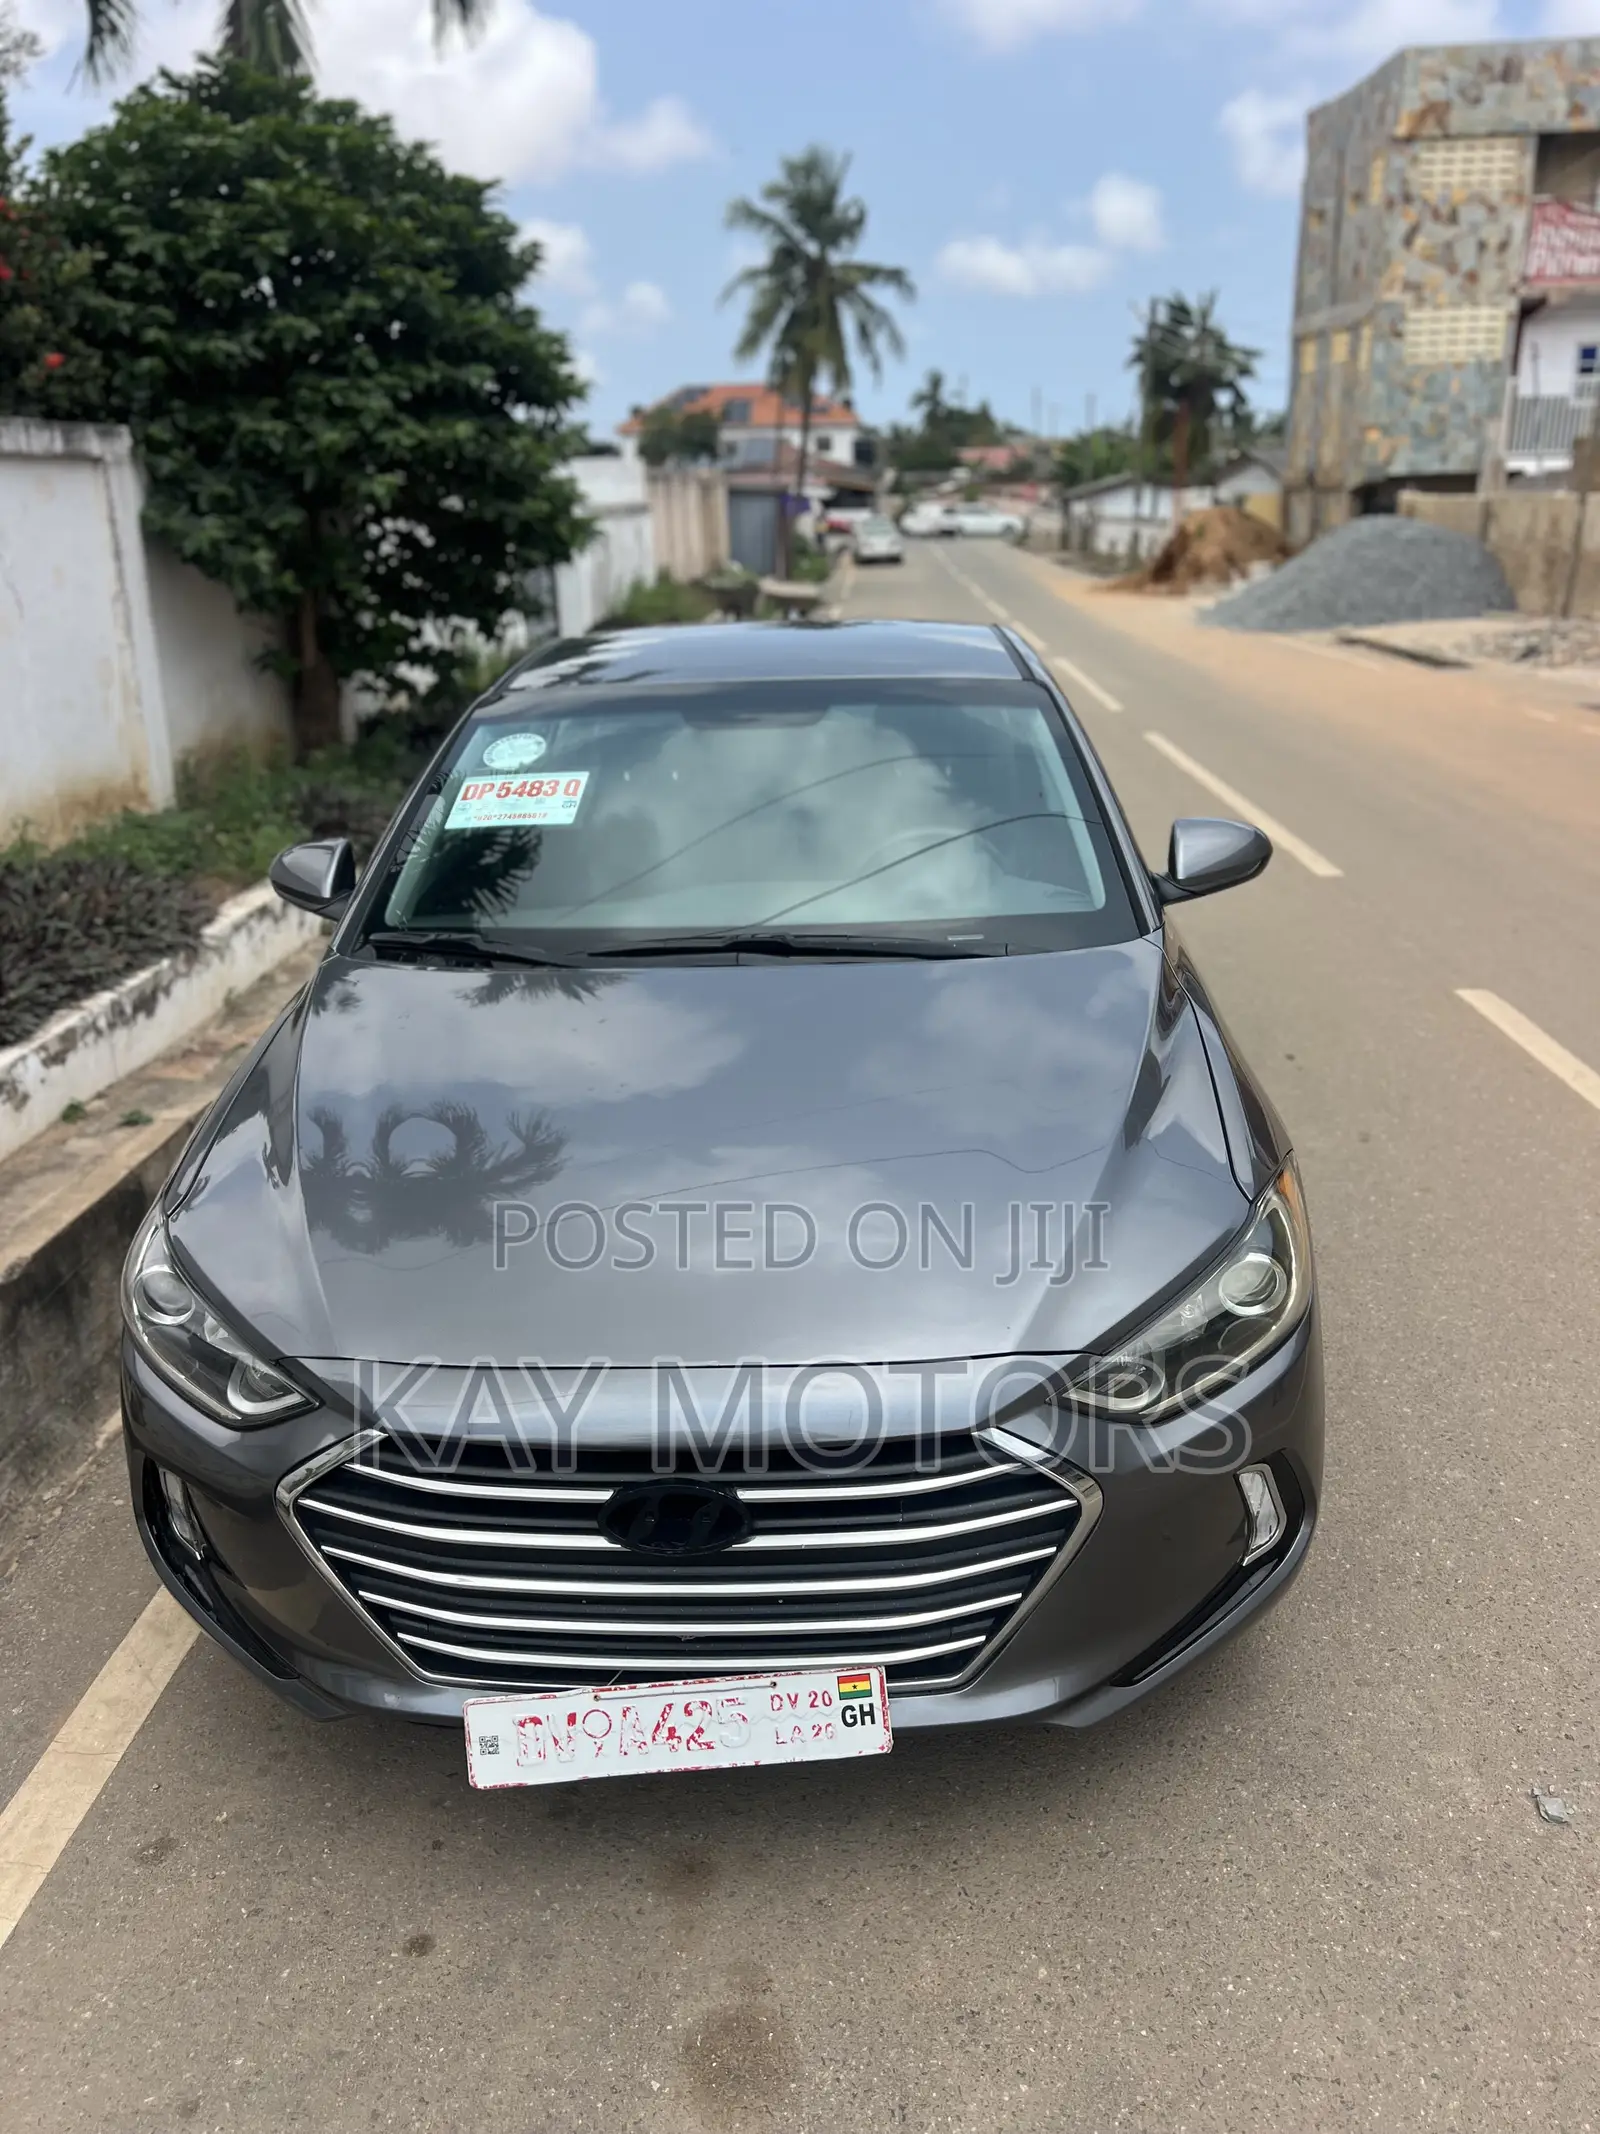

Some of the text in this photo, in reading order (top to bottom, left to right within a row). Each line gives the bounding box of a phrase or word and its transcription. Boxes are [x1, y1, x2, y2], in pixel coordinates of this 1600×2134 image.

[461, 778, 582, 801] DP 5483 Q
[769, 1690, 833, 1712] DV 20
[619, 1697, 752, 1757] A425
[841, 1703, 876, 1728] GH
[775, 1725, 807, 1745] LA
